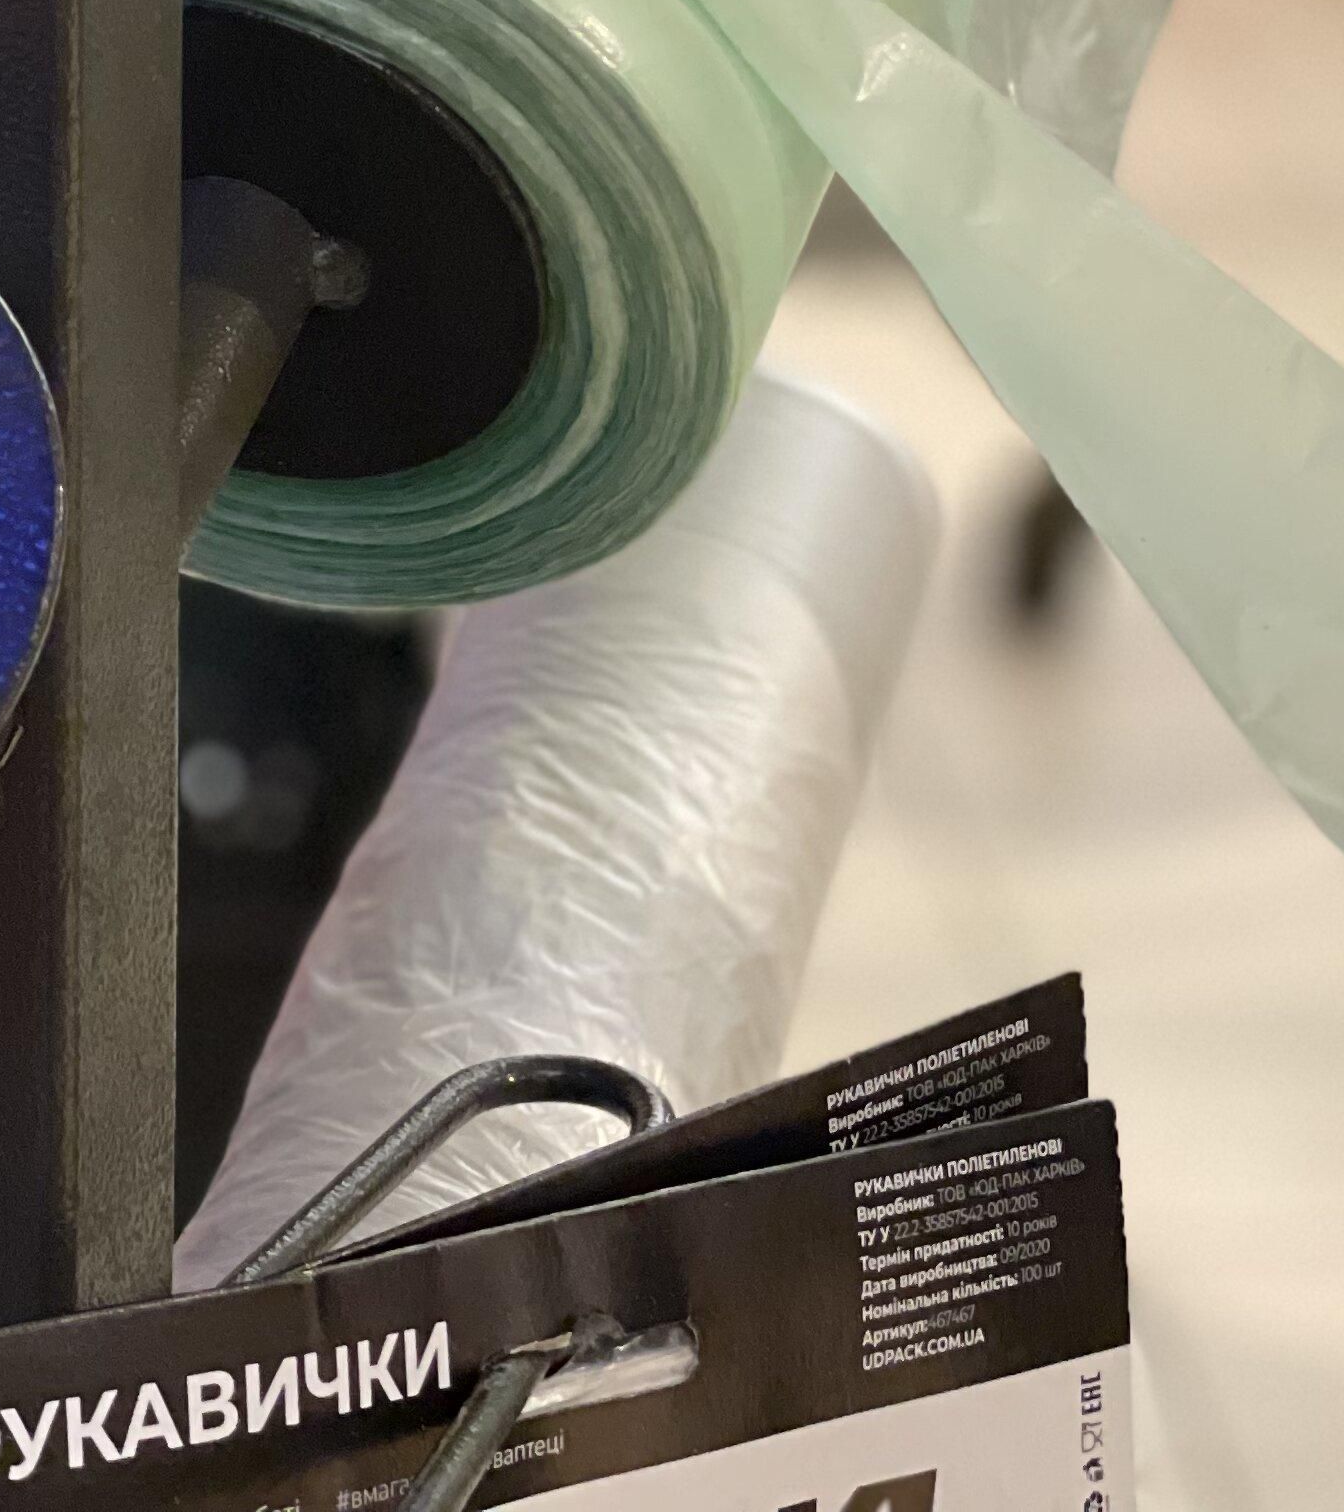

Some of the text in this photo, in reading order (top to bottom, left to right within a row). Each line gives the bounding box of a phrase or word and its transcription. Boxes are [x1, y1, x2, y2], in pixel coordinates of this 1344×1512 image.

[826, 1017, 1029, 1111] РУКАВИЧКИ ПОЛІЕТИЛЕНОВІ
[906, 1079, 935, 1102] ТОВ
[972, 1104, 987, 1123] 10
[854, 1137, 1063, 1198] РУКАВИЧКИ ПОЛІЕТИЛЕНОВІ
[856, 1194, 935, 1223] Виробник:
[937, 1184, 966, 1205] ТОВ
[858, 1229, 877, 1248] ТУ
[879, 1226, 890, 1244] У
[860, 1214, 1057, 1273] Термін придатності: 10 років
[861, 1238, 1051, 1301] Дата виробництва: 09/2020
[862, 1261, 1062, 1322] Номінальна кількість: 100 шт
[862, 1328, 985, 1371] UDPACK.COM.UA
[336, 1428, 565, 1511] #вмага ваптеці
